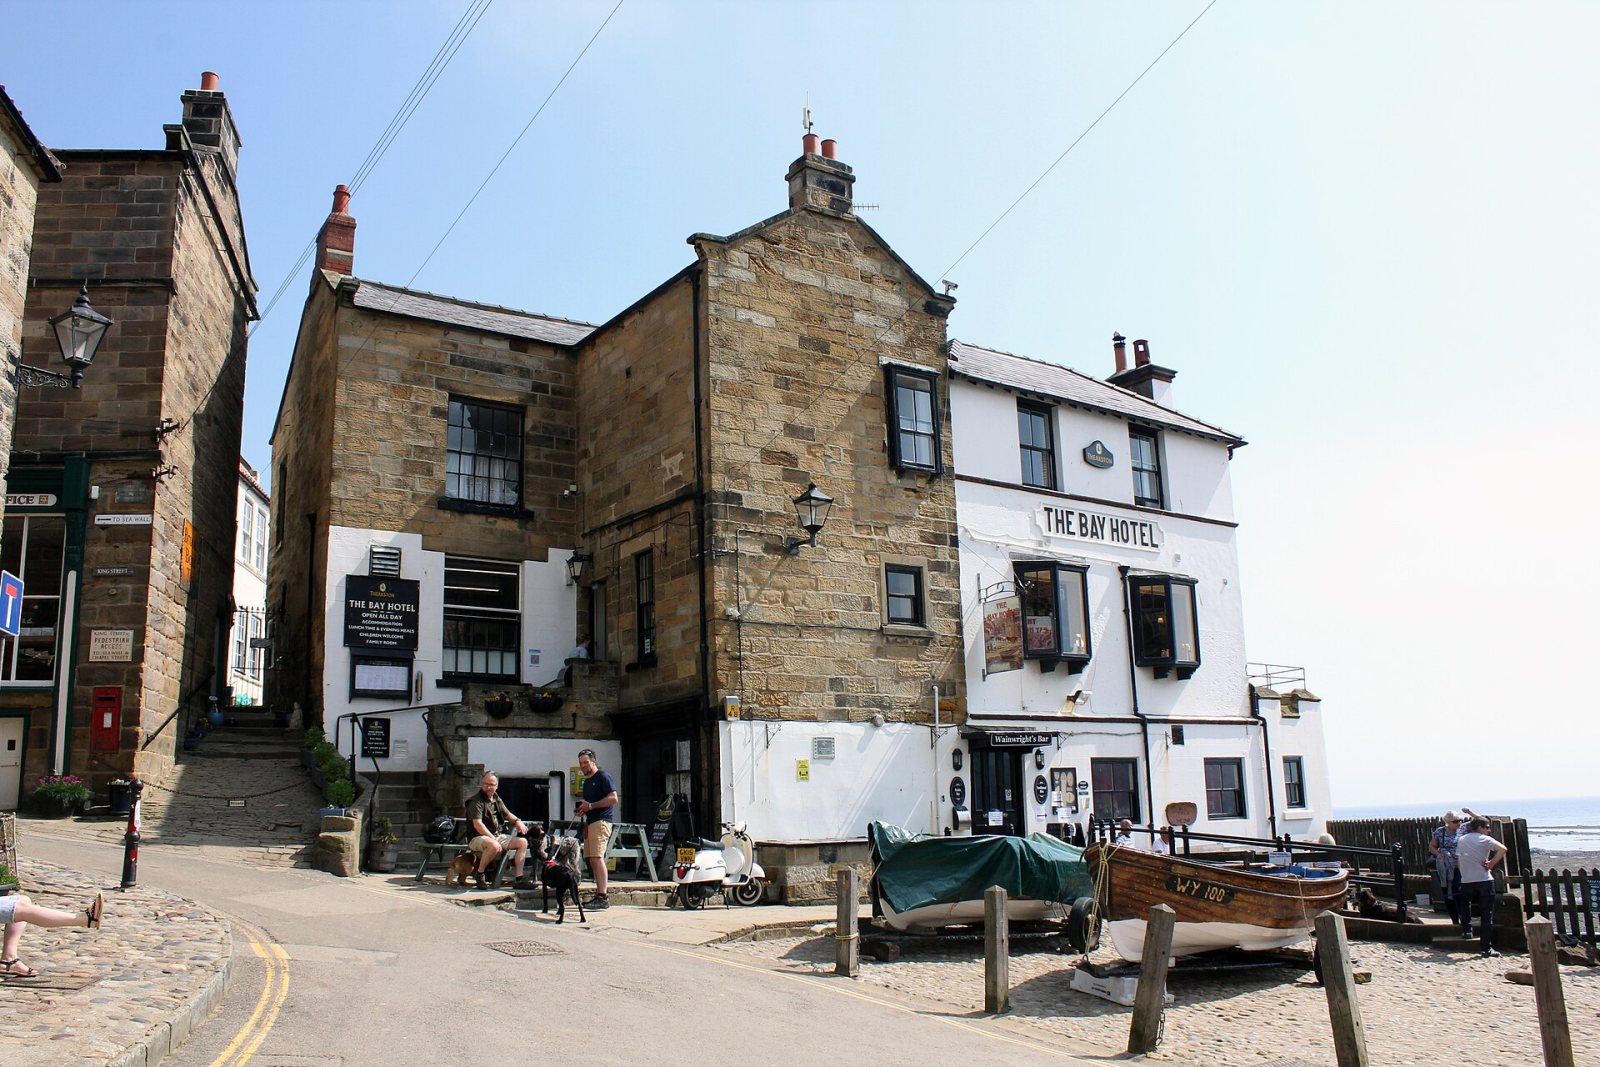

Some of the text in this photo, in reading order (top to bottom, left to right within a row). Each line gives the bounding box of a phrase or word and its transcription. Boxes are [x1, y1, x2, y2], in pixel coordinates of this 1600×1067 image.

[1043, 507, 1159, 549] THE BAY HOTEL
[349, 599, 416, 612] THE BAY HOTEL
[994, 734, 1050, 744] Wainwright's Bar
[1176, 877, 1226, 902] WY 100
